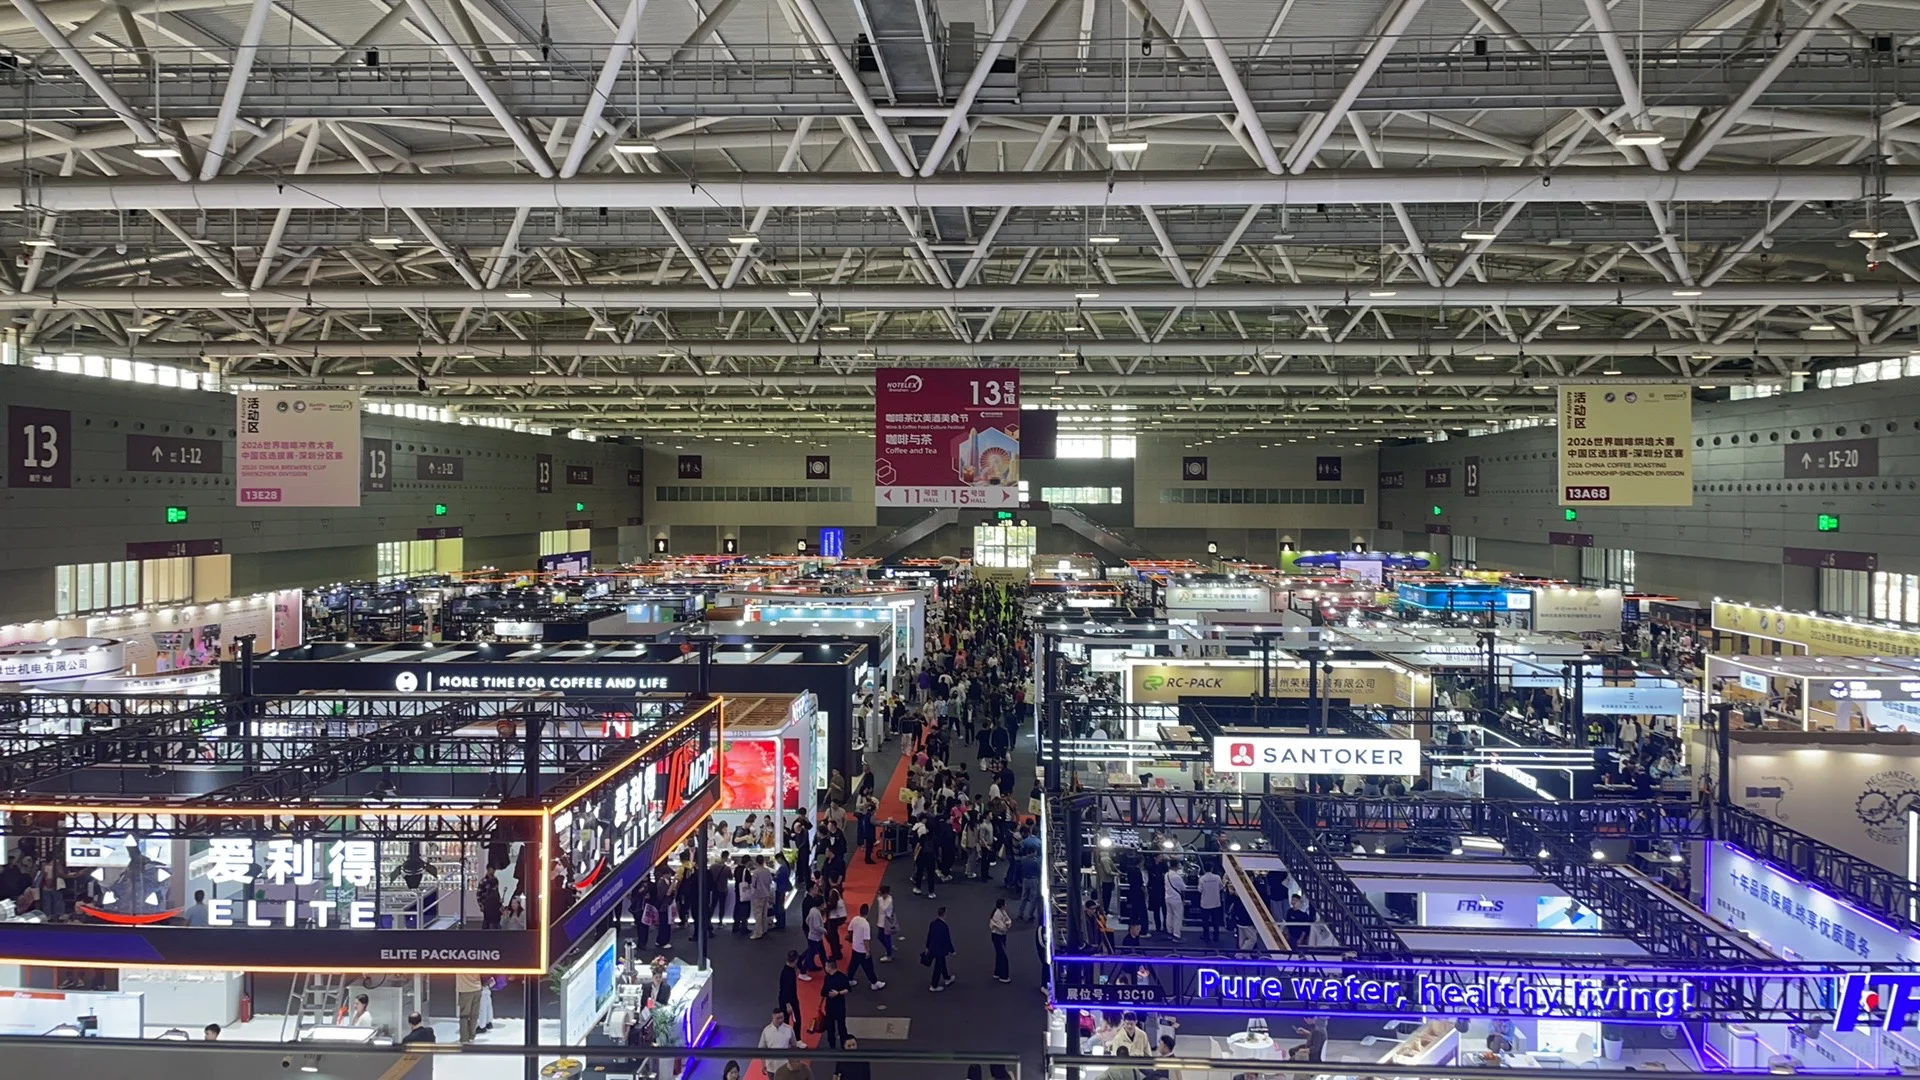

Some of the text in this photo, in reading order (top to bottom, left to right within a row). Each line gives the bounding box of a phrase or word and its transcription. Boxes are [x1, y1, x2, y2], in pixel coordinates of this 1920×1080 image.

[970, 380, 1016, 405] 13 号馆
[885, 413, 969, 423] 咖啡茶饮美酒美食节
[23, 424, 58, 468] 13
[885, 433, 933, 445] 咖啡与茶
[180, 447, 202, 464] 1-12
[369, 449, 386, 479] 13
[1828, 449, 1858, 468] 15-20
[540, 462, 550, 483] 13
[1467, 465, 1477, 487] 13
[245, 490, 278, 500] 13E28
[904, 490, 921, 504] 11
[951, 490, 970, 504] 15
[1568, 489, 1607, 499] 13A68
[439, 676, 667, 688] MORE TIME FOR COFFEE AND LIFE
[1166, 678, 1223, 688] RC-PACK
[1263, 748, 1403, 765] SANTOKER
[614, 762, 657, 828] 爱利得
[613, 810, 656, 866] ELITE
[207, 838, 376, 887] 爱利得
[207, 899, 376, 928] ELITE
[380, 949, 501, 961] ELITE PACKAGING
[1116, 989, 1155, 1001] 13C10
[1197, 968, 1694, 1018] Pure water, healthy living!
